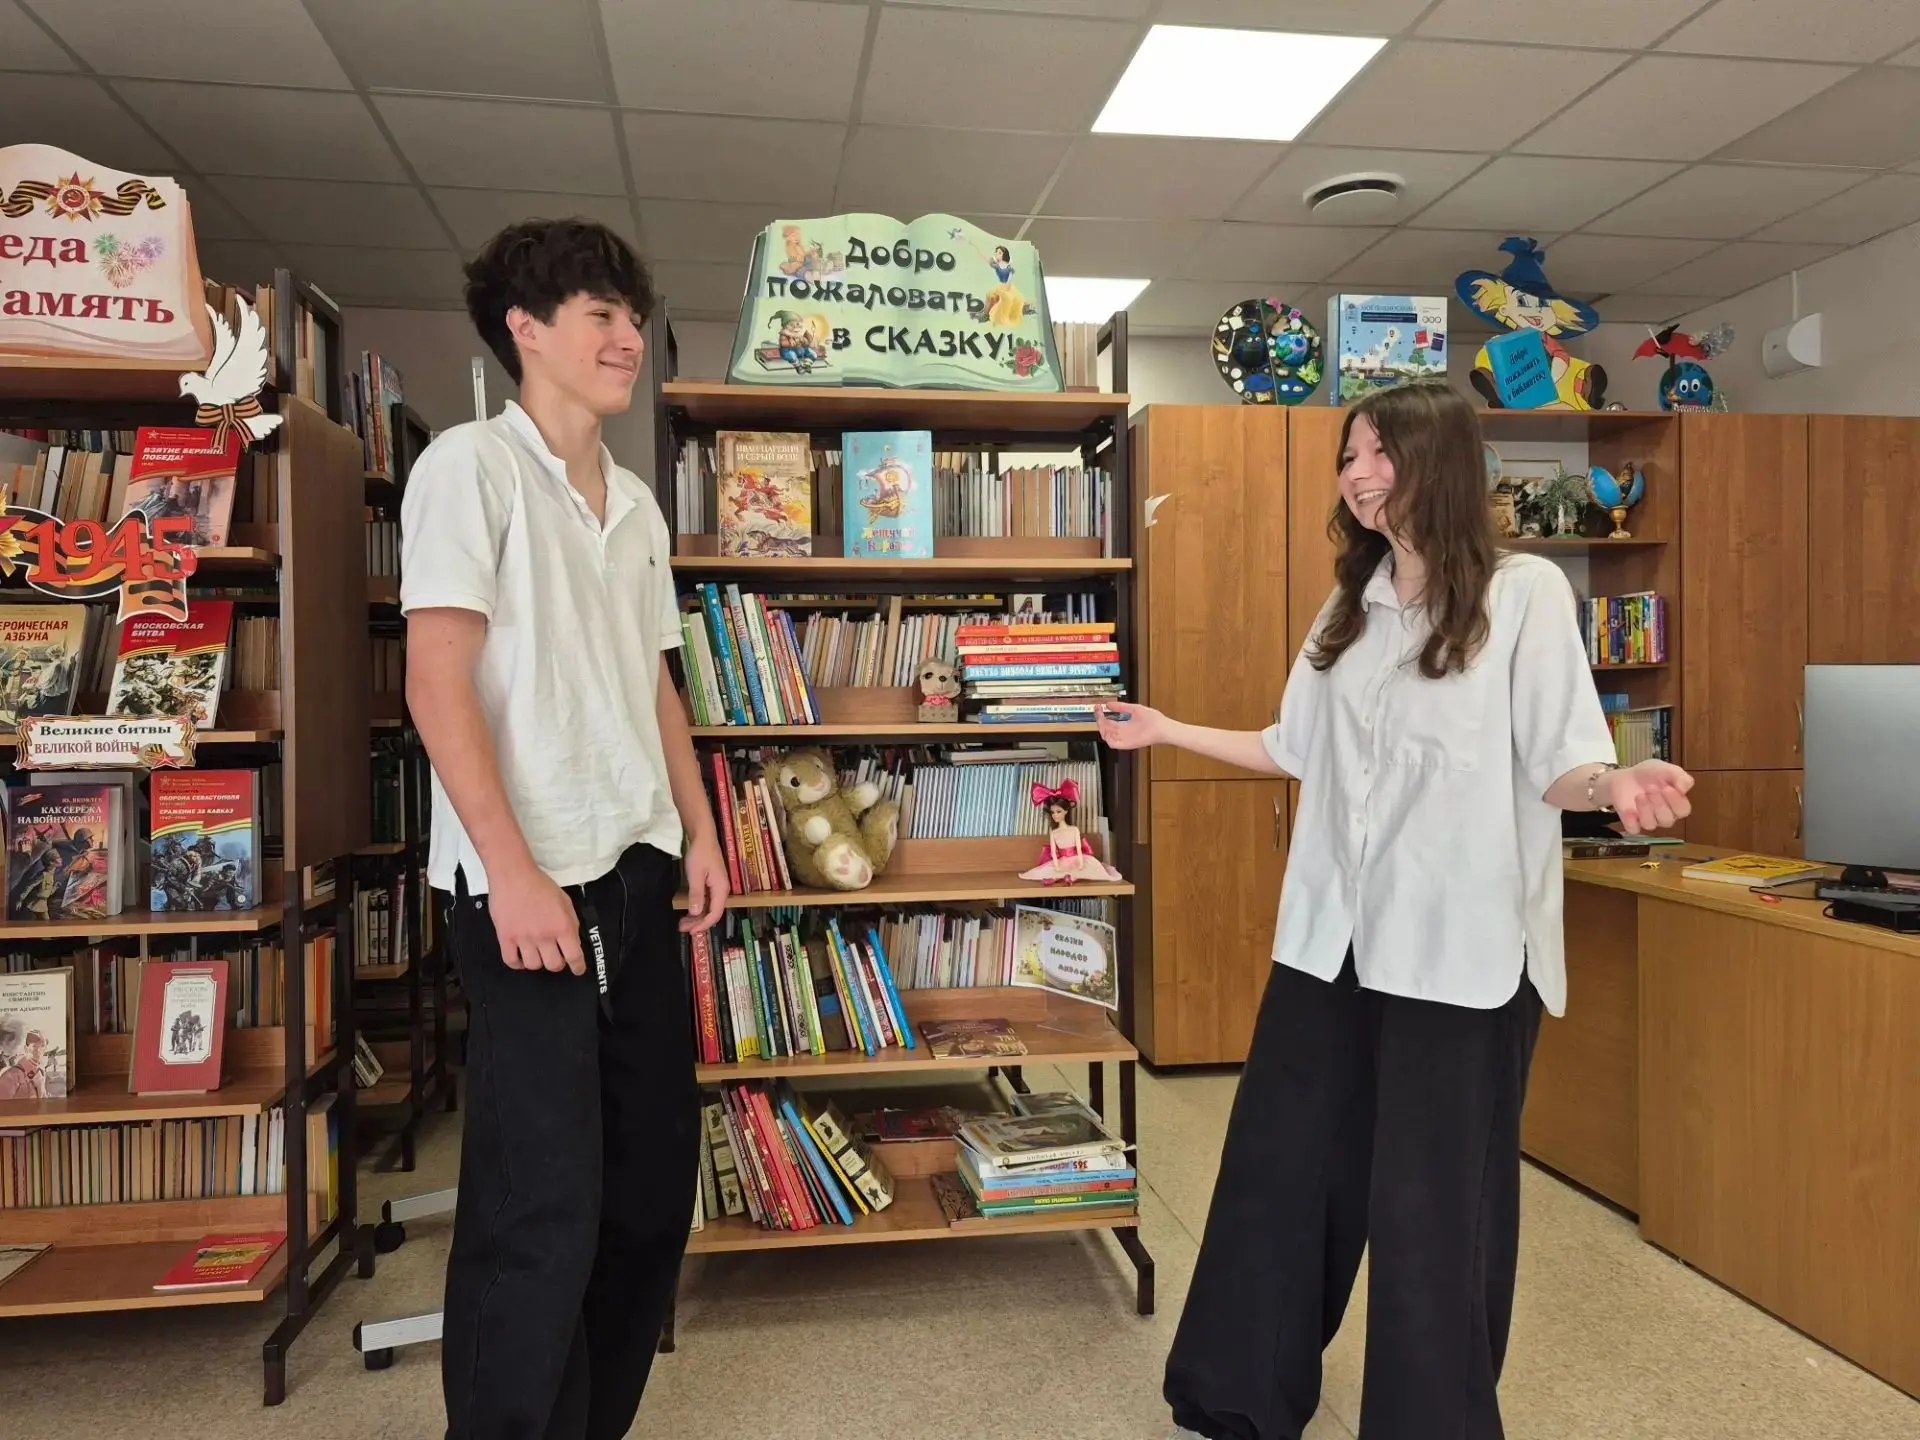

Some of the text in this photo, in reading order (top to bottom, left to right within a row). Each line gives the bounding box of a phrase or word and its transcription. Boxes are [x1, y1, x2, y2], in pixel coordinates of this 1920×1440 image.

[845, 236, 957, 275] Добро
[766, 275, 986, 316] пожаловать
[0, 288, 175, 325] амять
[832, 325, 1015, 362] в СКАЗКУ!
[143, 446, 182, 454] ВЗЯТИЕ
[141, 454, 184, 462] ПОБЕДА!
[24, 515, 197, 583] 1945
[132, 622, 205, 630] МОСКОВСКАЯ
[4, 631, 49, 642] АЗБУКА
[131, 629, 165, 637] БИТВА
[39, 723, 172, 737] Великие битвы
[34, 739, 141, 754] ВЕЛИКОЙ ВОЙНЫ
[41, 804, 103, 814] КАК СЕРЁЖА
[17, 814, 103, 824] НА ВОЙНУ ХОДИЛ
[588, 925, 608, 995] VETEMENTS
[1072, 1160, 1089, 1170] 365
